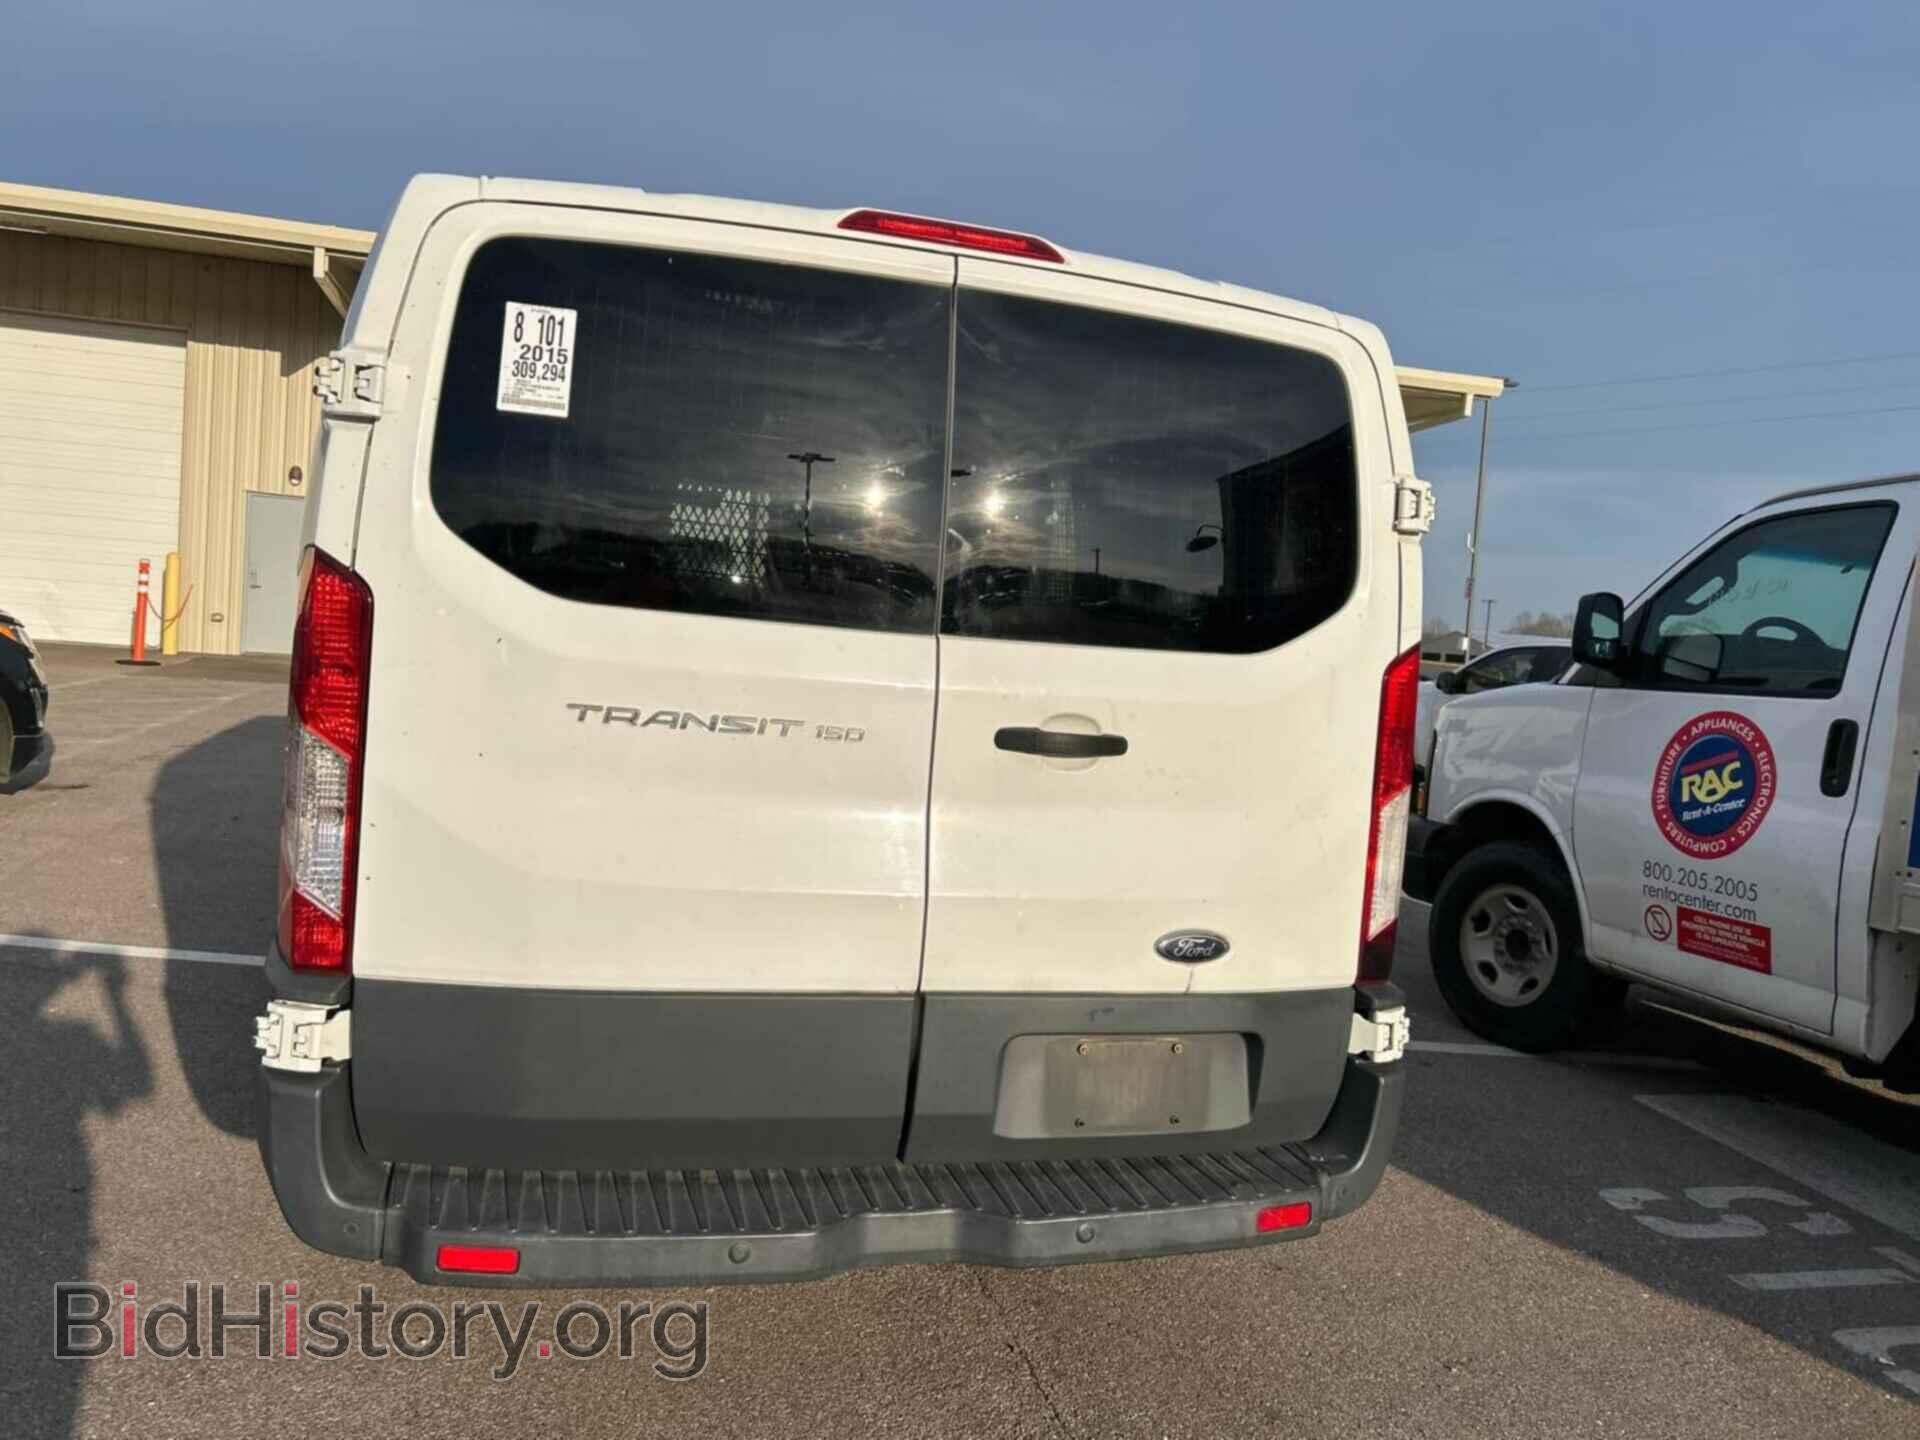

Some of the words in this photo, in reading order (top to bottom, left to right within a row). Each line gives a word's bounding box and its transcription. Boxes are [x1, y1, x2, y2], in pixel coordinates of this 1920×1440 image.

[514, 311, 525, 342] 8
[538, 315, 565, 347] 101
[512, 360, 566, 382] 309,294
[519, 344, 568, 364] 2015
[565, 702, 806, 737] TRANSIT
[815, 724, 866, 743] 150
[1691, 718, 1755, 741] APPLIANCES
[1656, 742, 1681, 810] FURNITURE
[1681, 761, 1744, 803] RAC
[1737, 751, 1771, 836] ELECTRONICS
[1666, 822, 1727, 852] COMPUTERS
[1643, 860, 1758, 902] 800.205.2005
[1642, 883, 1757, 922] rentacenter.com
[1173, 937, 1216, 958] Ford
